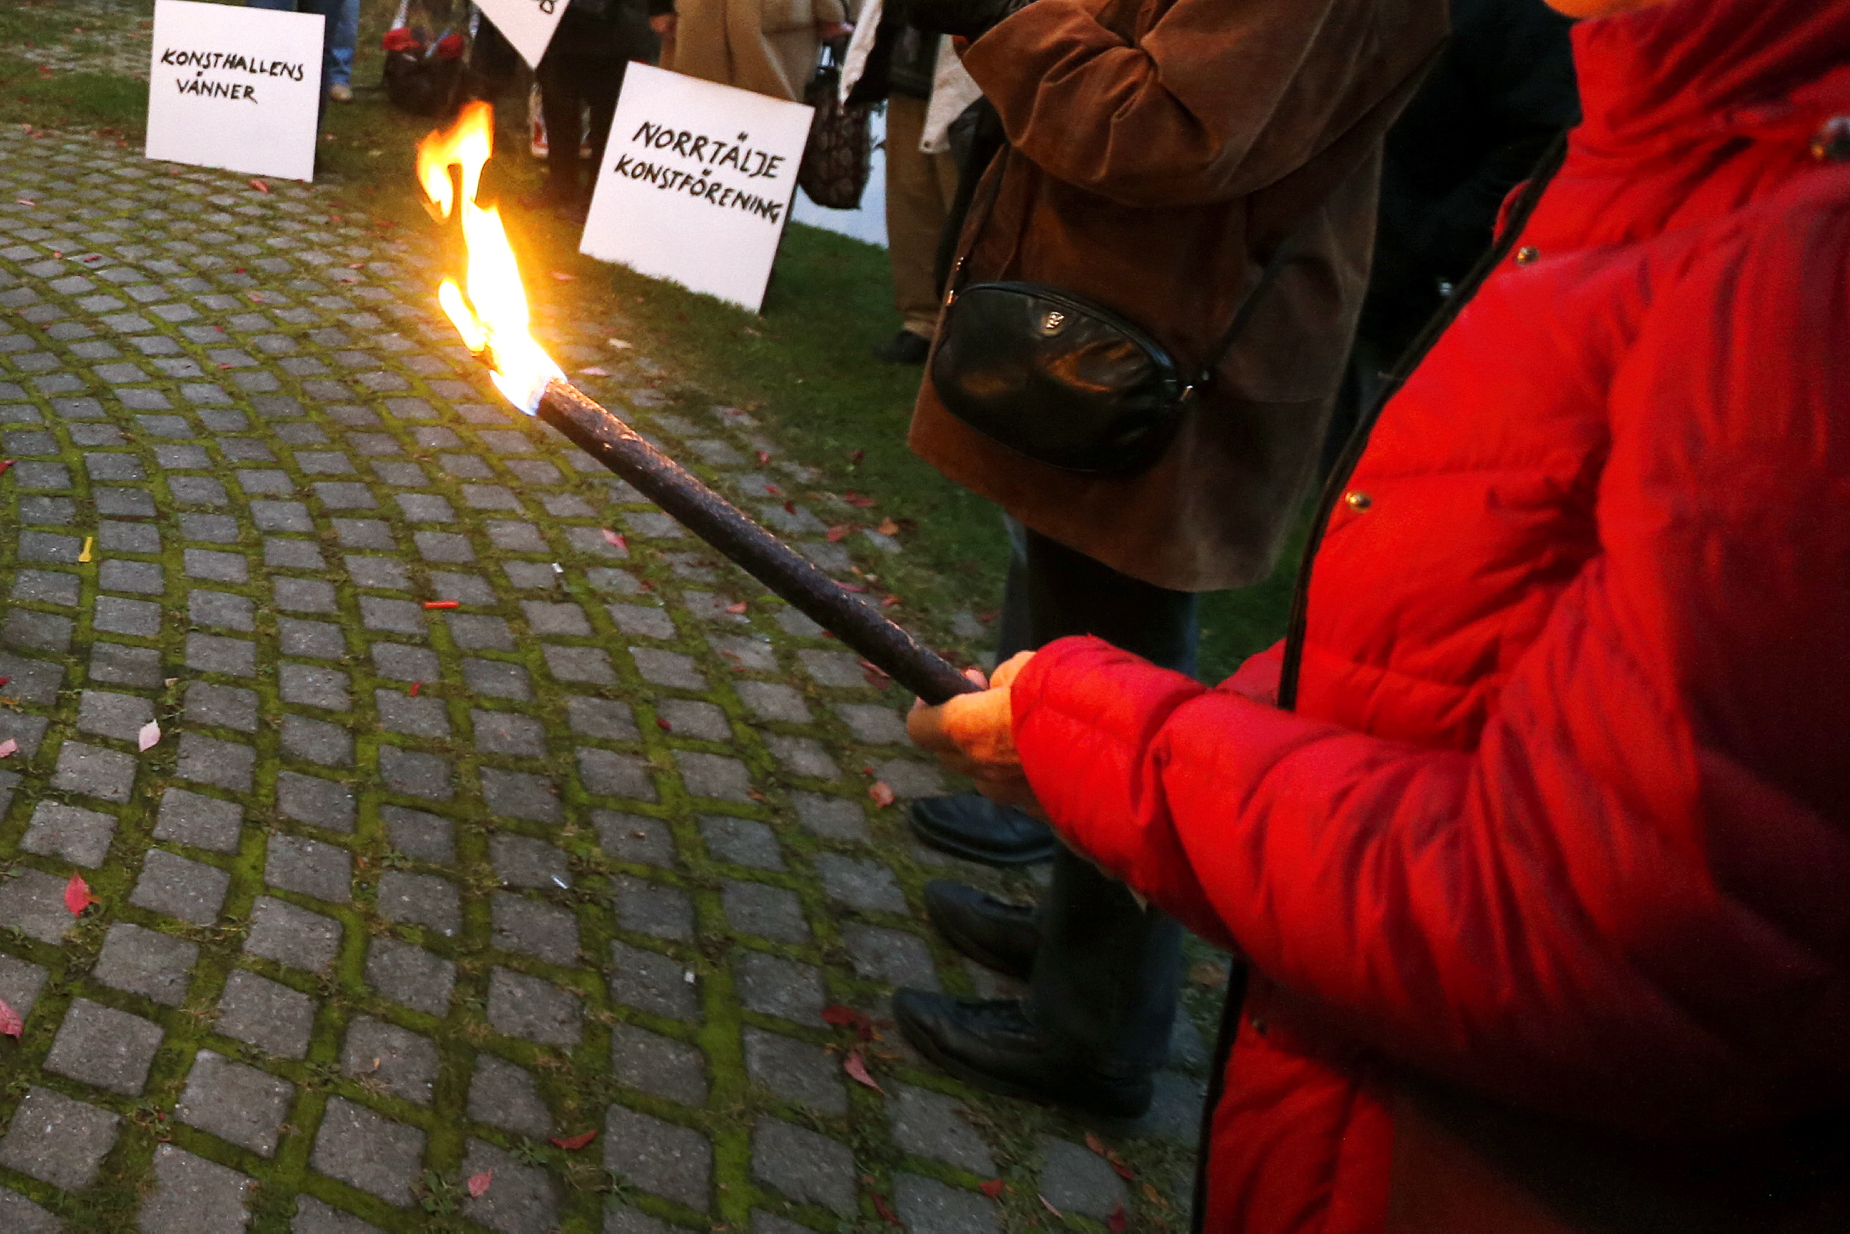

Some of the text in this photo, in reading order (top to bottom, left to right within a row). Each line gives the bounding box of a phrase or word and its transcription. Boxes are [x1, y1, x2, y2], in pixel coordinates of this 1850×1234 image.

[161, 47, 305, 82] KONSTHALLENS
[176, 71, 258, 105] VÄNNER
[632, 121, 786, 179] NORRTÄLJE
[614, 153, 784, 224] KONSTFÖRENING
